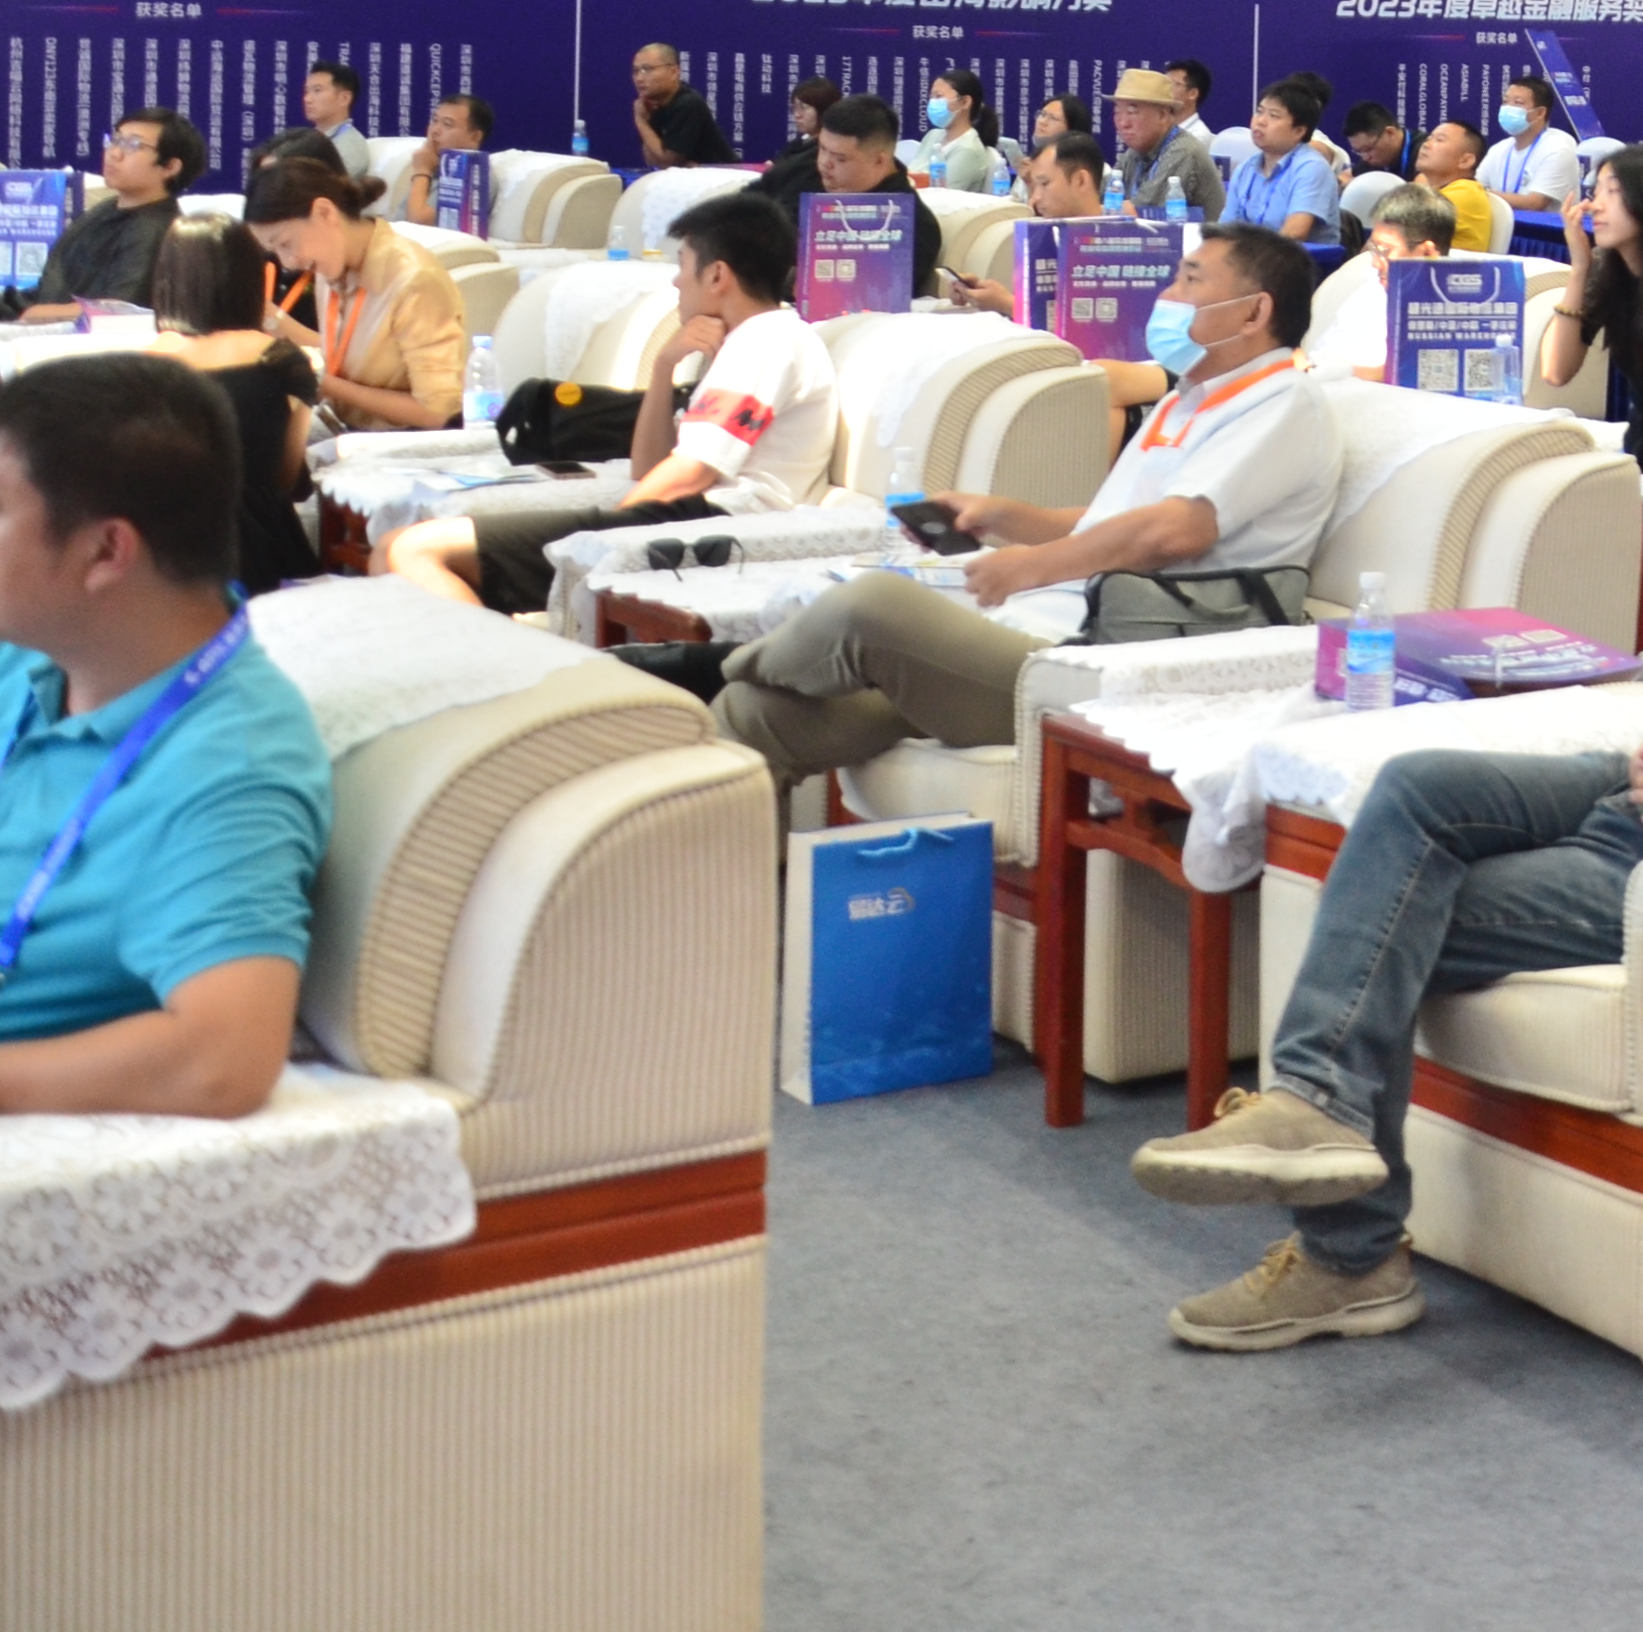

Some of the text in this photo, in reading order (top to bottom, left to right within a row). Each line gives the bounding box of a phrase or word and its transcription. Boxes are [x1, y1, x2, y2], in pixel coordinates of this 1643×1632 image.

[135, 2, 202, 19] 获奖名单
[911, 24, 965, 40] 获奖名单
[1475, 31, 1518, 46] 获奖名单
[1440, 63, 1450, 123] OCEANPAYME
